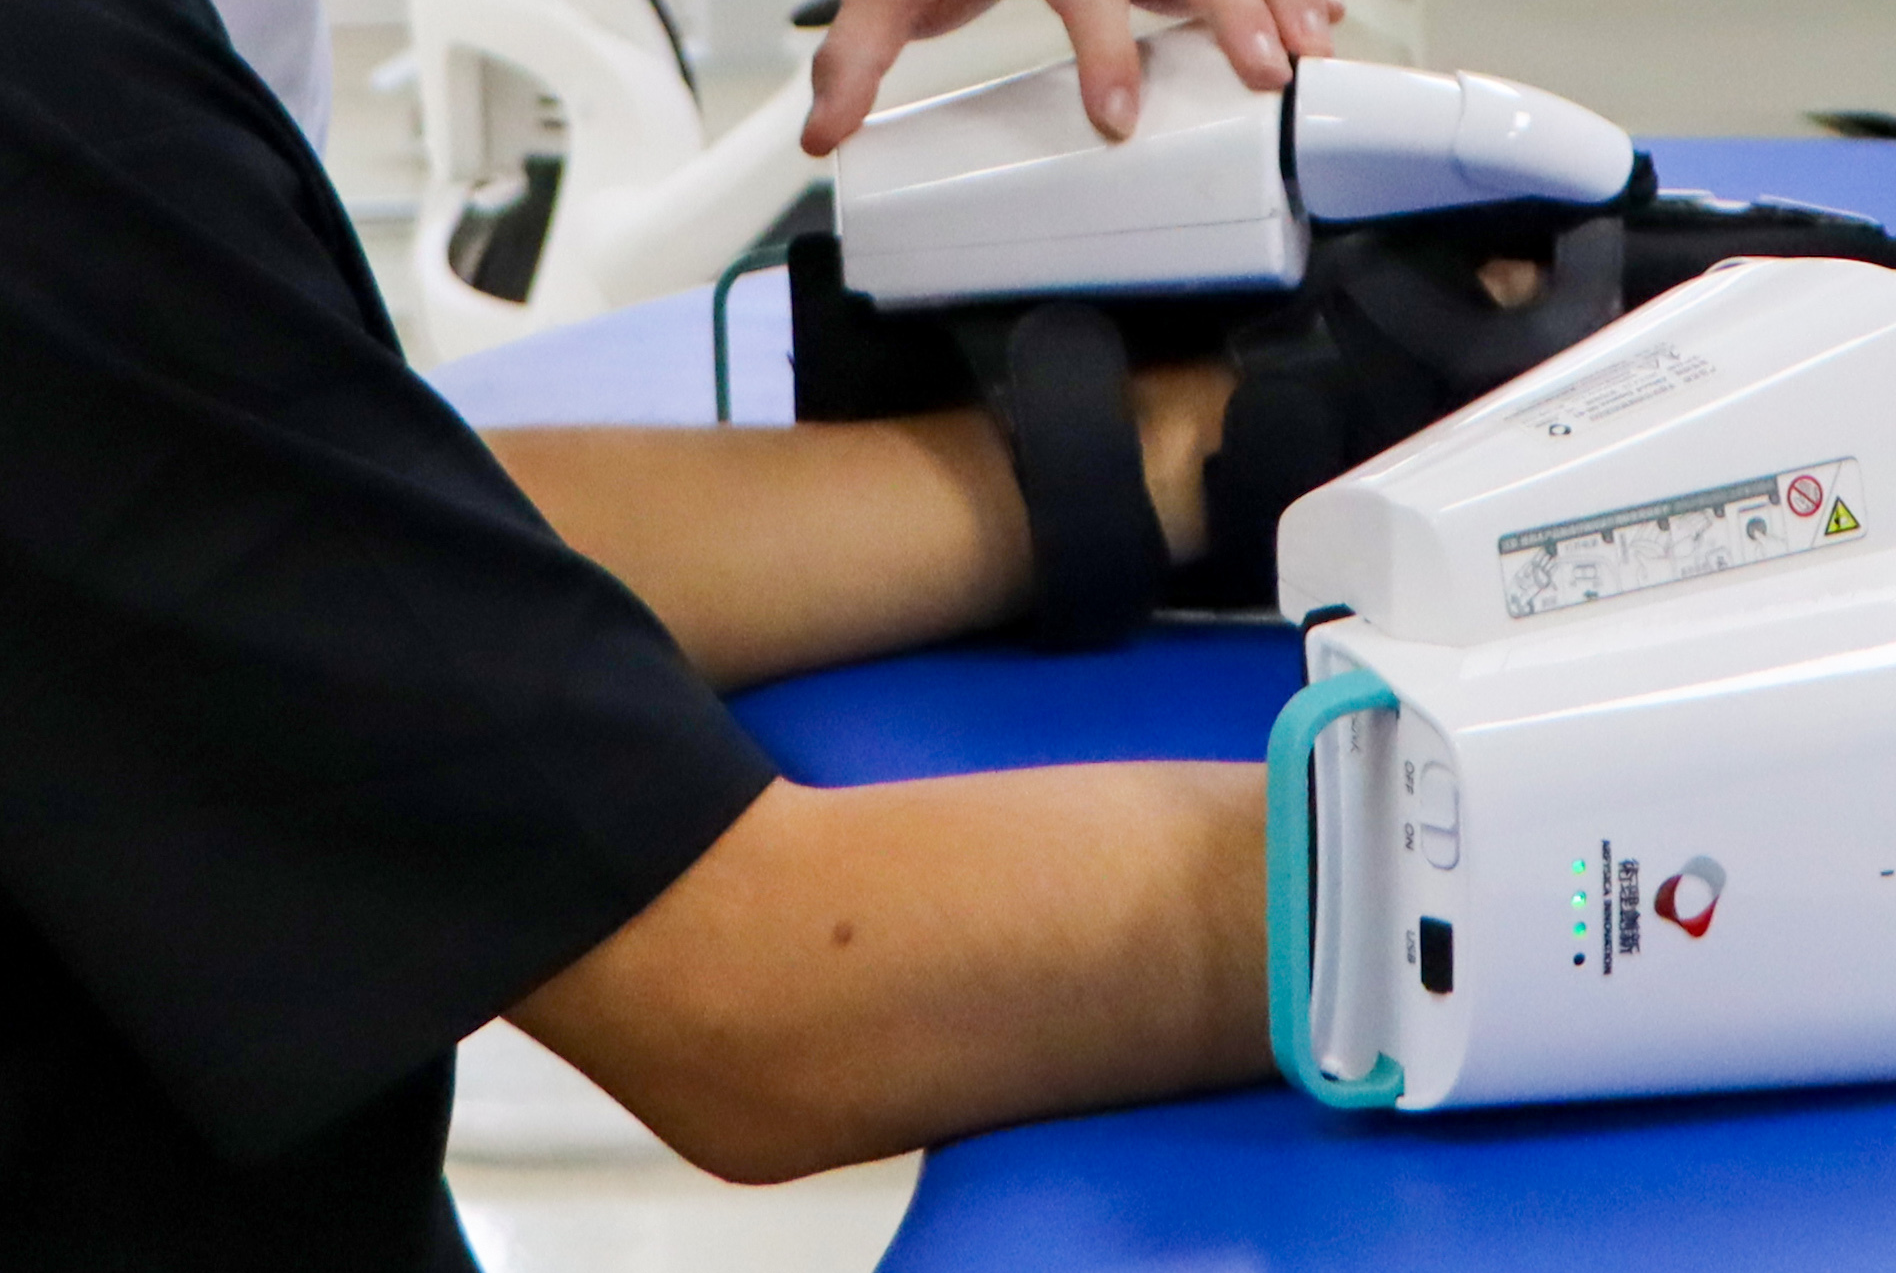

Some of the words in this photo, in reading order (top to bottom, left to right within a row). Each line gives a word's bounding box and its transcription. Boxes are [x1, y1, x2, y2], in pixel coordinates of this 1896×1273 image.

[1404, 761, 1415, 795] OFF
[1405, 823, 1415, 851] ON
[1407, 929, 1416, 965] USB
